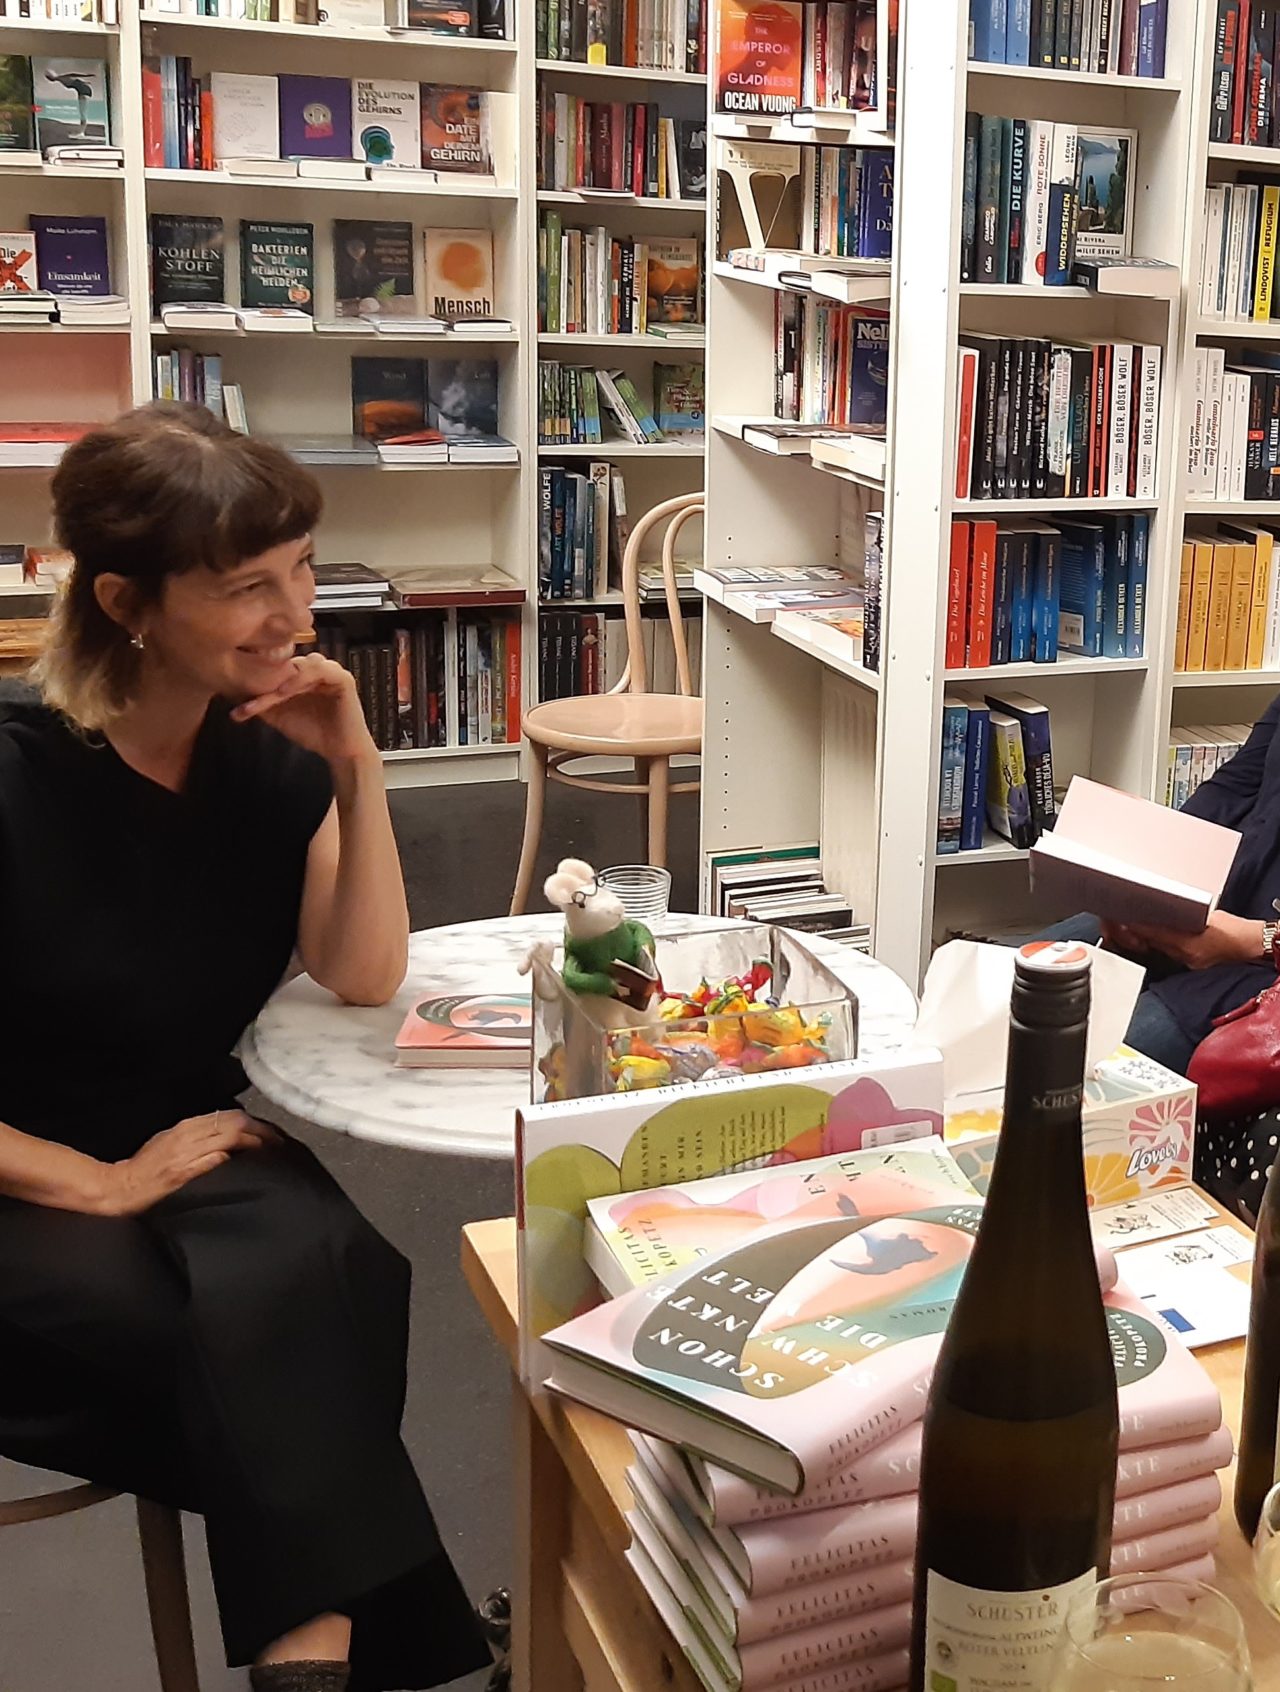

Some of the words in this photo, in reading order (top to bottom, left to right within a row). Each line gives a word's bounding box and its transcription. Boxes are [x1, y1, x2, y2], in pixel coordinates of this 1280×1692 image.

[731, 41, 791, 55] EMPEROR
[357, 81, 374, 91] DIE
[727, 72, 794, 87] GLADNESS
[357, 89, 415, 101] EVOLUTION
[358, 97, 378, 106] DES
[724, 91, 759, 111] OCEAN
[761, 94, 797, 113] VUONG
[1259, 77, 1267, 109] FIRMA
[358, 104, 402, 115] GEHIRNS
[1257, 110, 1265, 127] DIE
[445, 123, 478, 136] DATE
[430, 149, 481, 163] GEHIRN
[1012, 125, 1026, 182] KURVE
[1038, 133, 1047, 166] SONNE
[1037, 166, 1045, 196] ROTE
[1011, 184, 1022, 212] DIE
[1036, 201, 1044, 219] BERG
[1035, 220, 1043, 246] ERIC
[1058, 192, 1072, 272] WIDDERSEHEN
[1264, 202, 1275, 248] REFUGIUM
[158, 247, 221, 260] KOHLEN
[251, 243, 308, 255] BAKTERIEN
[48, 271, 101, 281] Einsamkeit
[166, 260, 214, 273] STOFF
[251, 266, 308, 278] HEIMLICHEN
[1260, 256, 1270, 302] LINDQVIST
[260, 276, 299, 288] HELDEN
[434, 296, 491, 316] Mensch
[1118, 357, 1128, 380] WOLF
[1145, 359, 1156, 382] WOLF
[1117, 384, 1127, 411] BÖSER
[1144, 386, 1155, 413] BÖSER
[1115, 413, 1126, 444] BÖSER,
[1143, 415, 1155, 445] BÖSER,
[542, 473, 551, 510] WOLFE
[1042, 780, 1054, 815] TÖDLICHES
[637, 1218, 680, 1268] KOPETZ
[815, 1313, 888, 1349] DIE
[646, 1326, 784, 1391] SCHON
[828, 1404, 899, 1456] FELICITAS
[790, 1535, 889, 1571] FELICITAS
[776, 1582, 876, 1619] FELICITAS
[966, 1601, 1059, 1622] SCHUSTER
[780, 1626, 879, 1665] FELICITAS
